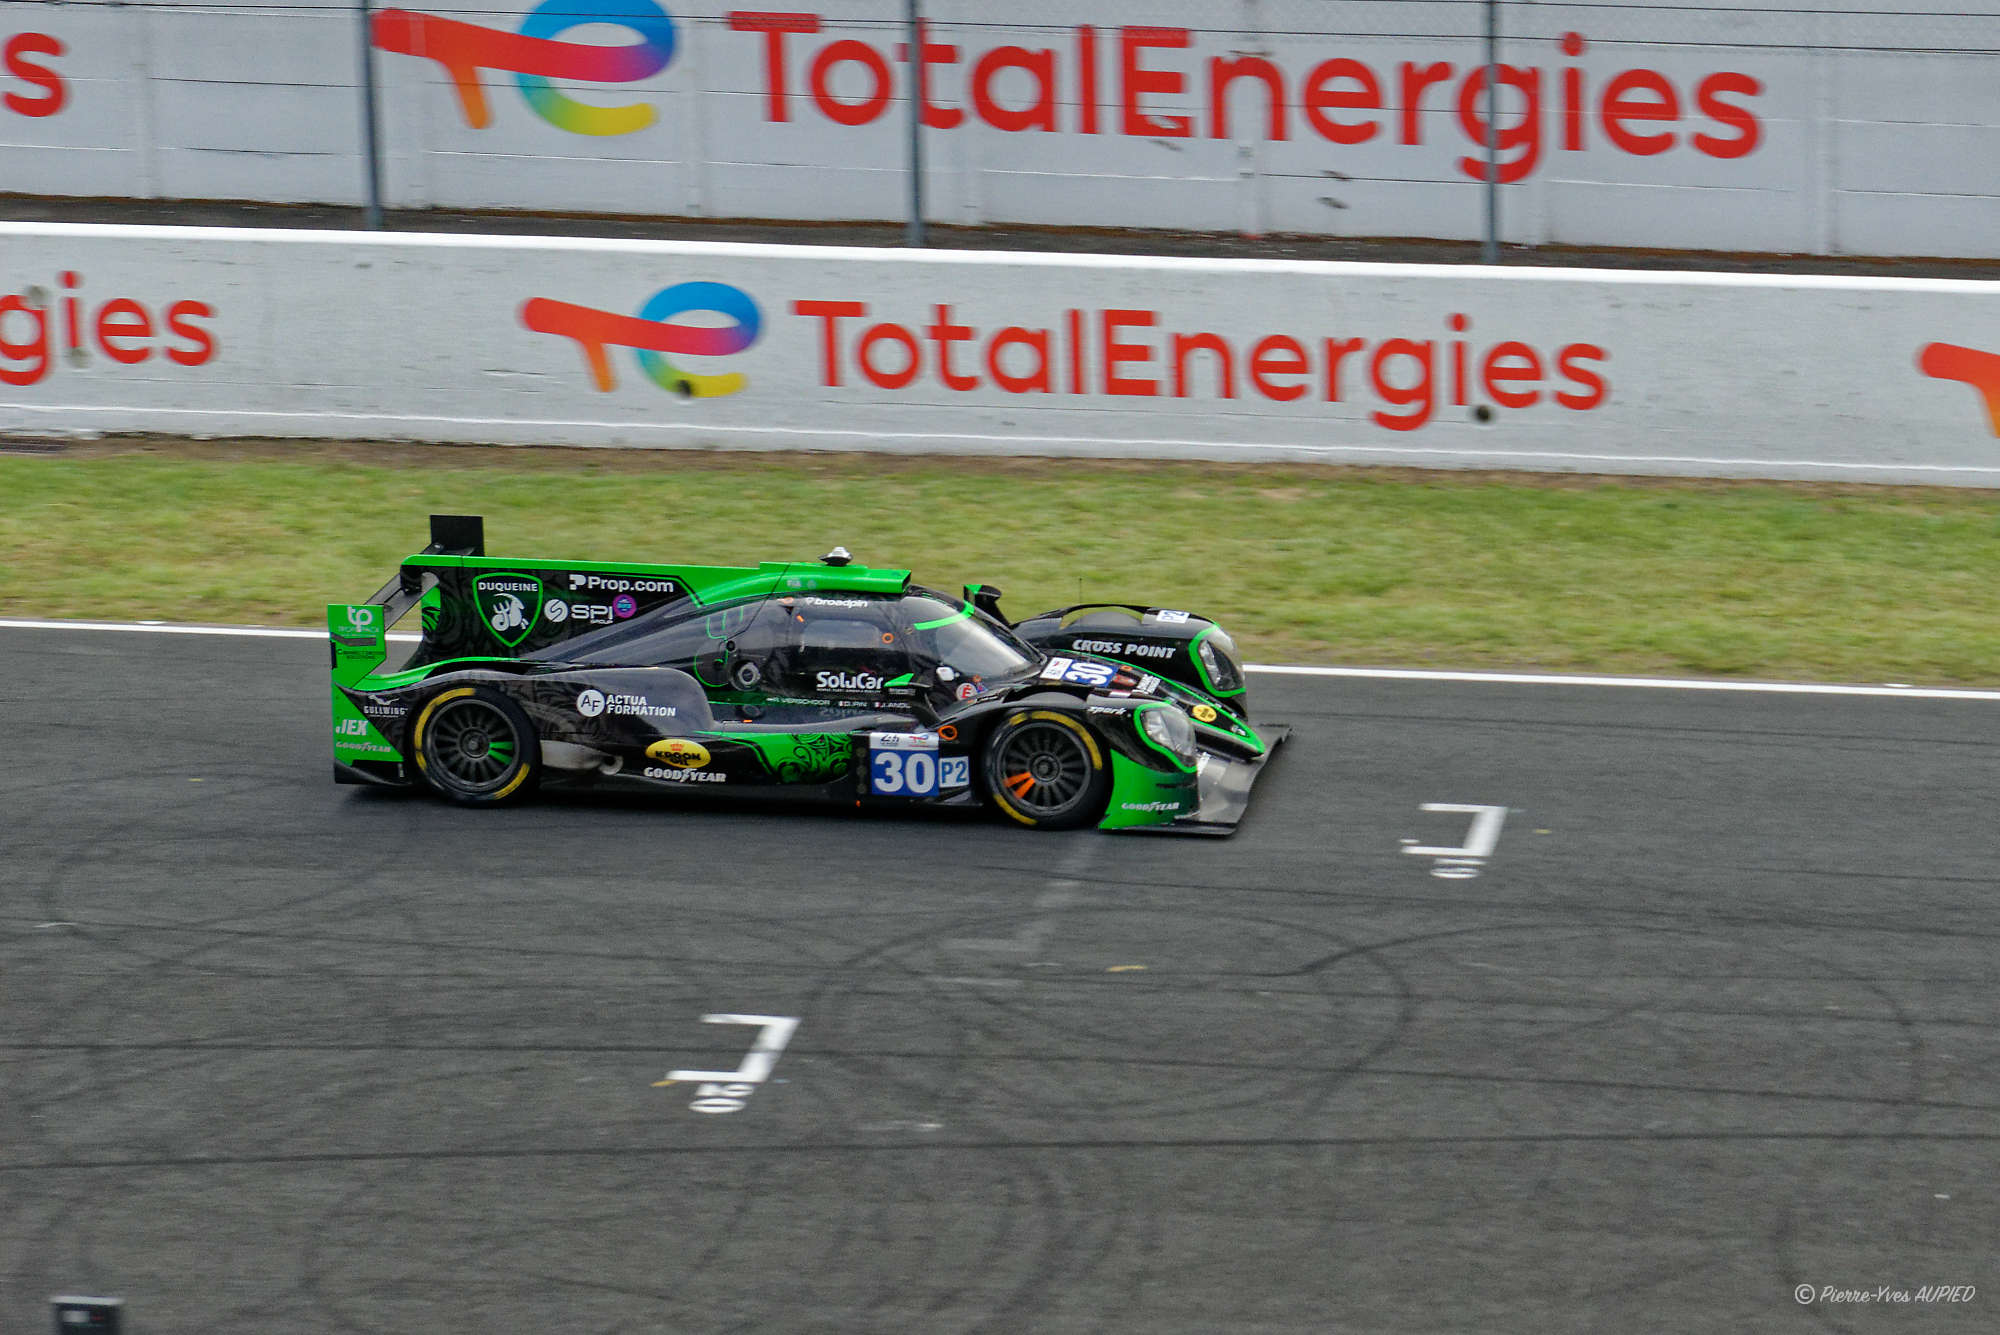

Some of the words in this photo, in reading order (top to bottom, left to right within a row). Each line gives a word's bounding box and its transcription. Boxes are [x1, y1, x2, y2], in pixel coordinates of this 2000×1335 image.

[727, 11, 1764, 184] TotalEnergies
[792, 299, 1610, 431] TotalEnergies
[478, 581, 539, 592] DUQUEINE
[587, 576, 675, 593] Prop.com
[814, 597, 868, 609] broadpin
[570, 604, 614, 621] SPI
[1072, 639, 1122, 654] CROSS
[1124, 643, 1177, 659] POINT
[815, 671, 885, 689] SoluCar
[606, 694, 648, 706] ACTUA
[606, 704, 676, 717] FORMATION
[642, 767, 727, 783] GOODYEAR
[874, 751, 936, 794] 30
[941, 760, 968, 784] P2
[1121, 801, 1180, 812] GOODYEAR
